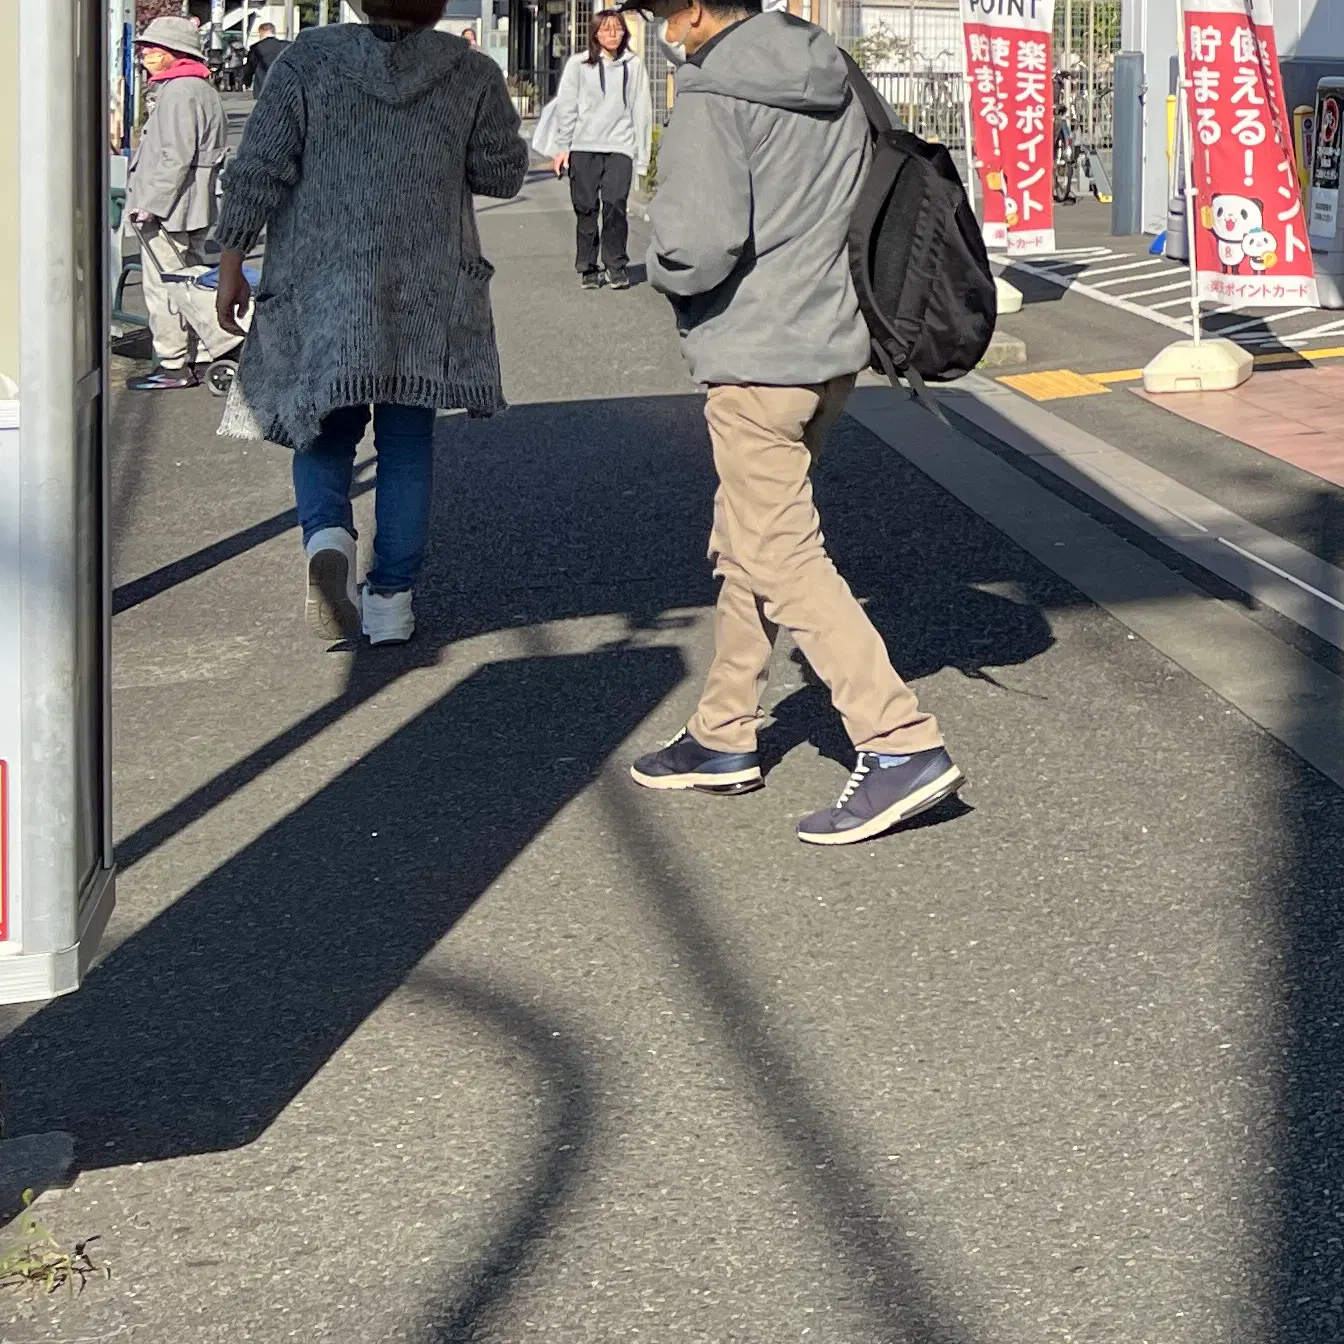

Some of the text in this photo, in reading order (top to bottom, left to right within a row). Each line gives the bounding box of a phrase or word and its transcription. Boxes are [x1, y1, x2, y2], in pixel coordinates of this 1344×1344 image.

[1015, 40, 1047, 221] 楽天ポイント
[1189, 24, 1222, 185] 貯まる!
[1229, 24, 1266, 187] 使える!
